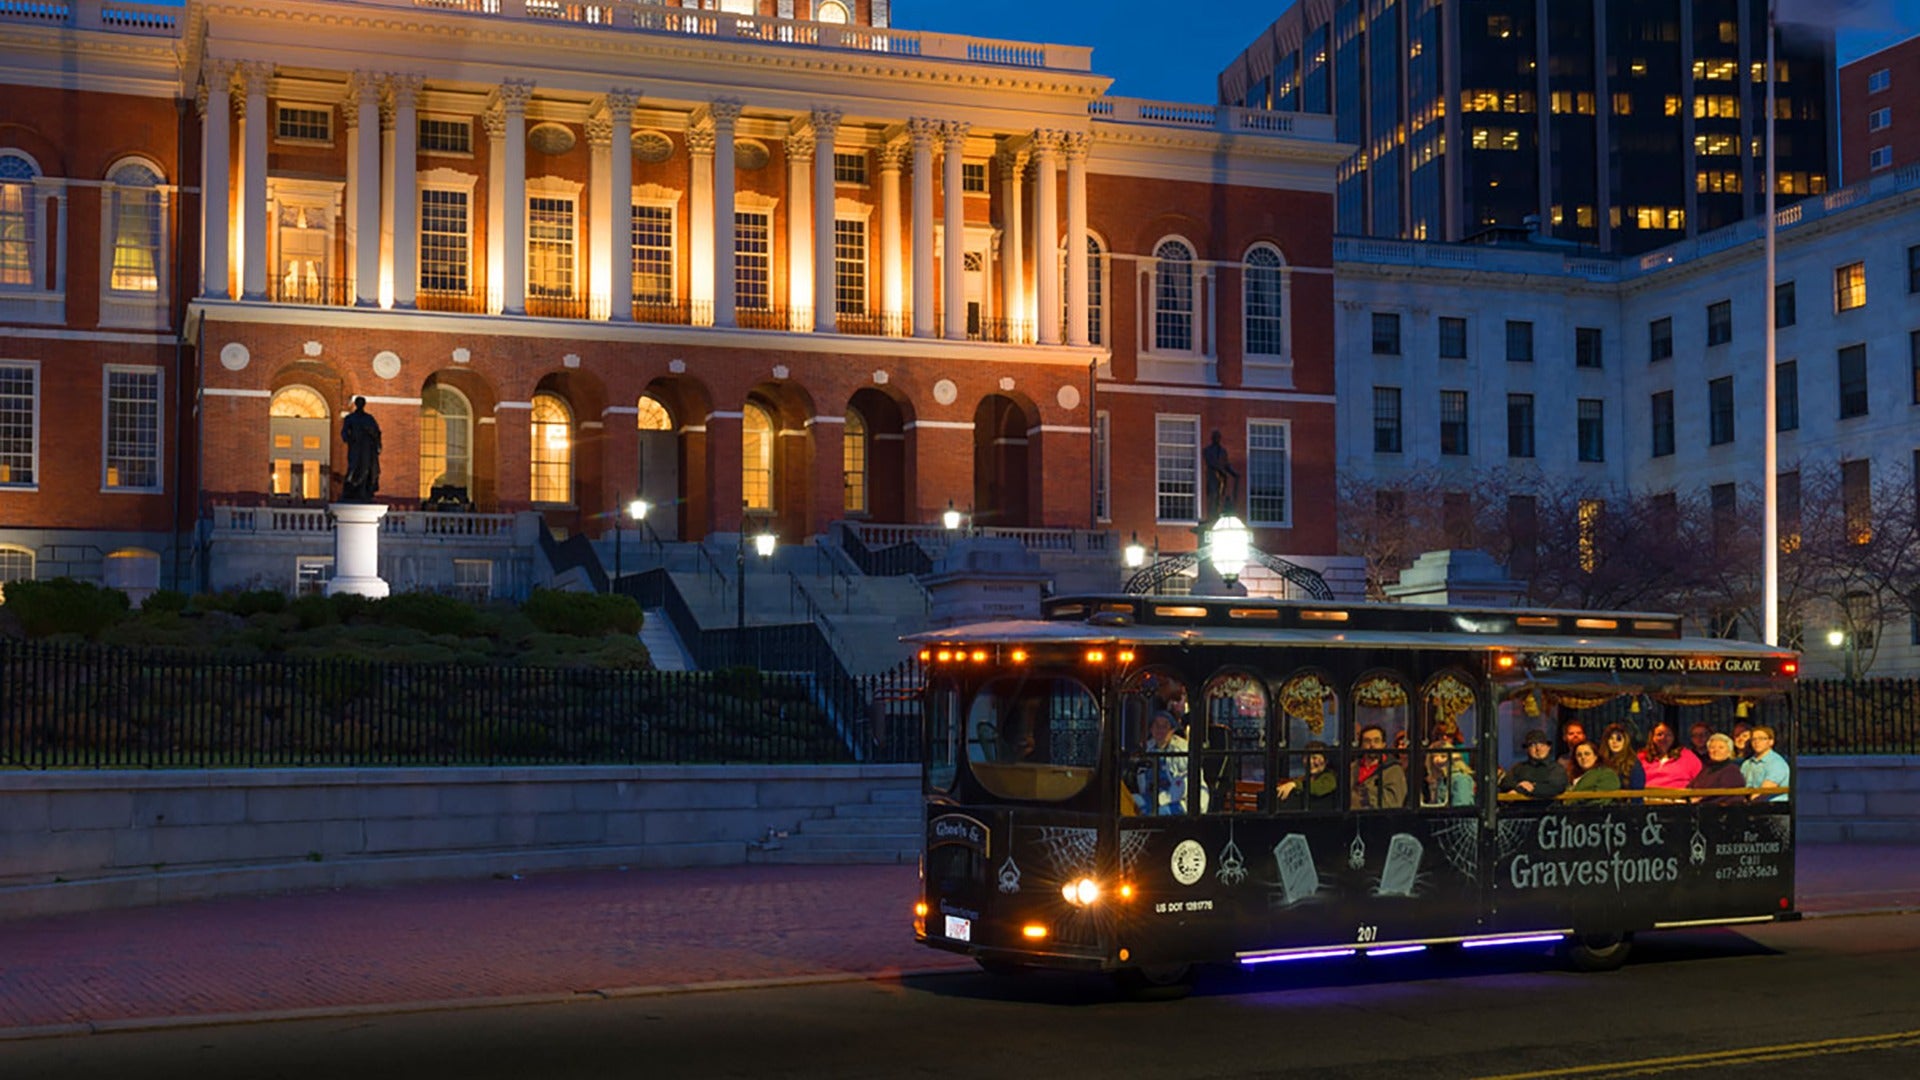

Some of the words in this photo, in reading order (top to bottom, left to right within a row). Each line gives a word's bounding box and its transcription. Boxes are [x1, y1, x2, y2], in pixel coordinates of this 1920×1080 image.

[1539, 655, 1576, 668] WE'LL
[1579, 655, 1616, 669] DRIVE
[1620, 657, 1644, 670] YOU
[1647, 657, 1665, 670] TO
[1667, 659, 1685, 670] AN
[1687, 659, 1722, 671] EARLY
[1725, 659, 1761, 672] GRAVE
[1538, 813, 1627, 854] Ghosts
[1641, 812, 1664, 846] &
[1510, 851, 1678, 892] Gravestones
[1155, 903, 1166, 913] US
[1168, 902, 1183, 912] DOT
[1357, 926, 1377, 942] 207
